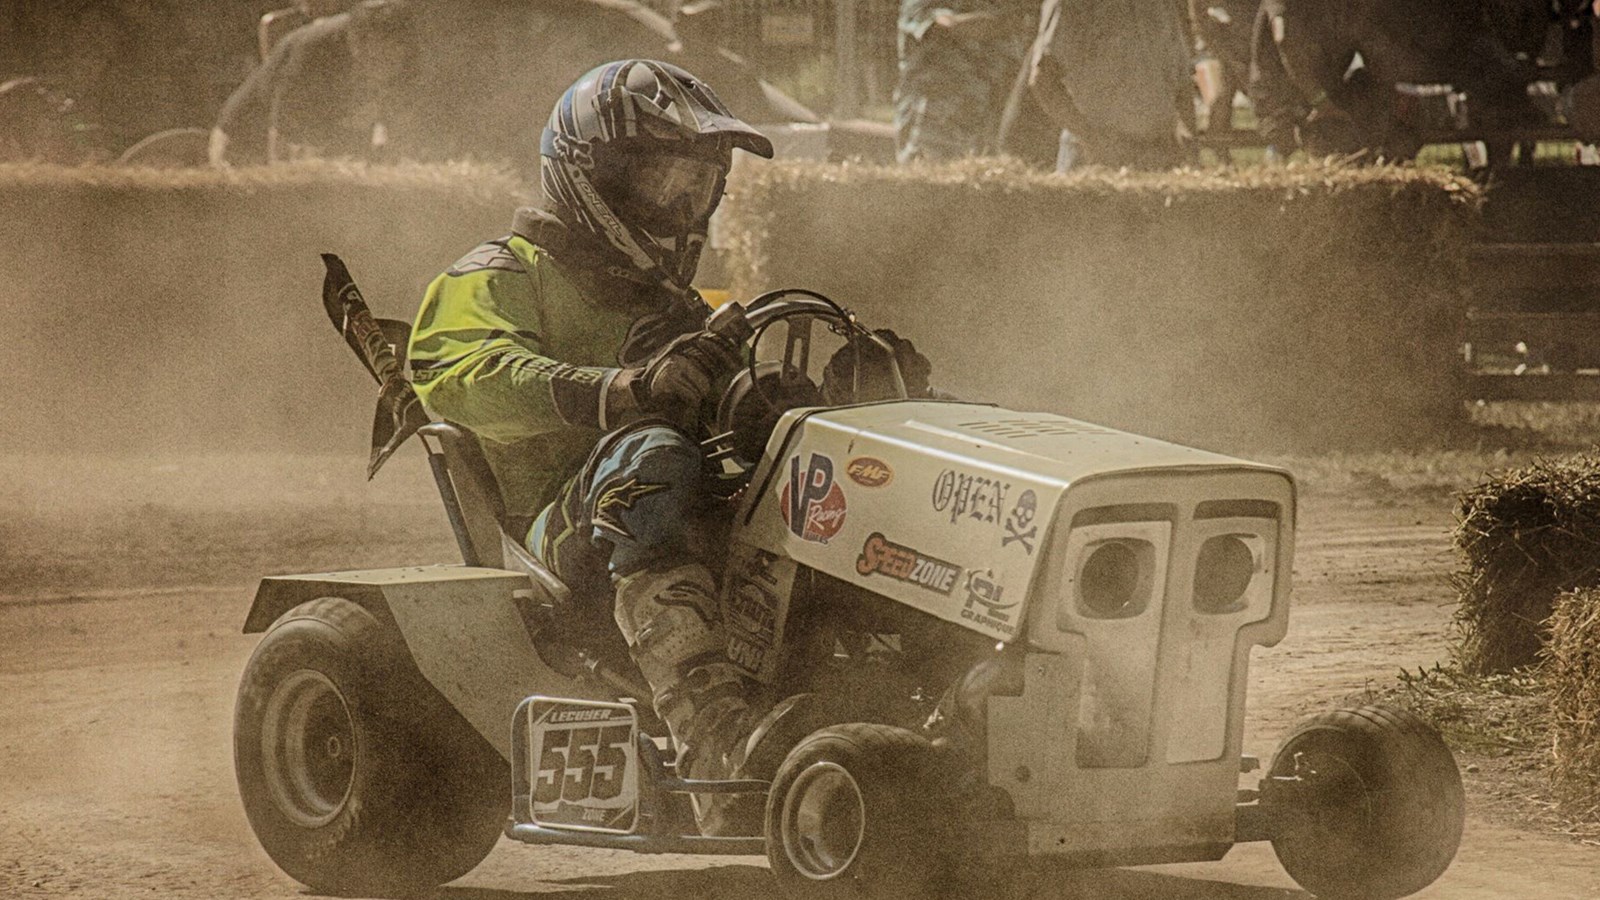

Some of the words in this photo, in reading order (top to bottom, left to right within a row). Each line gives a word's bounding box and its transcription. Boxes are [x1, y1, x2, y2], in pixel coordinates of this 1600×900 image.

[790, 453, 834, 538] VP
[848, 464, 890, 480] FMF
[932, 468, 1011, 525] OPEN
[551, 709, 612, 722] LECUYER
[535, 727, 628, 804] 555
